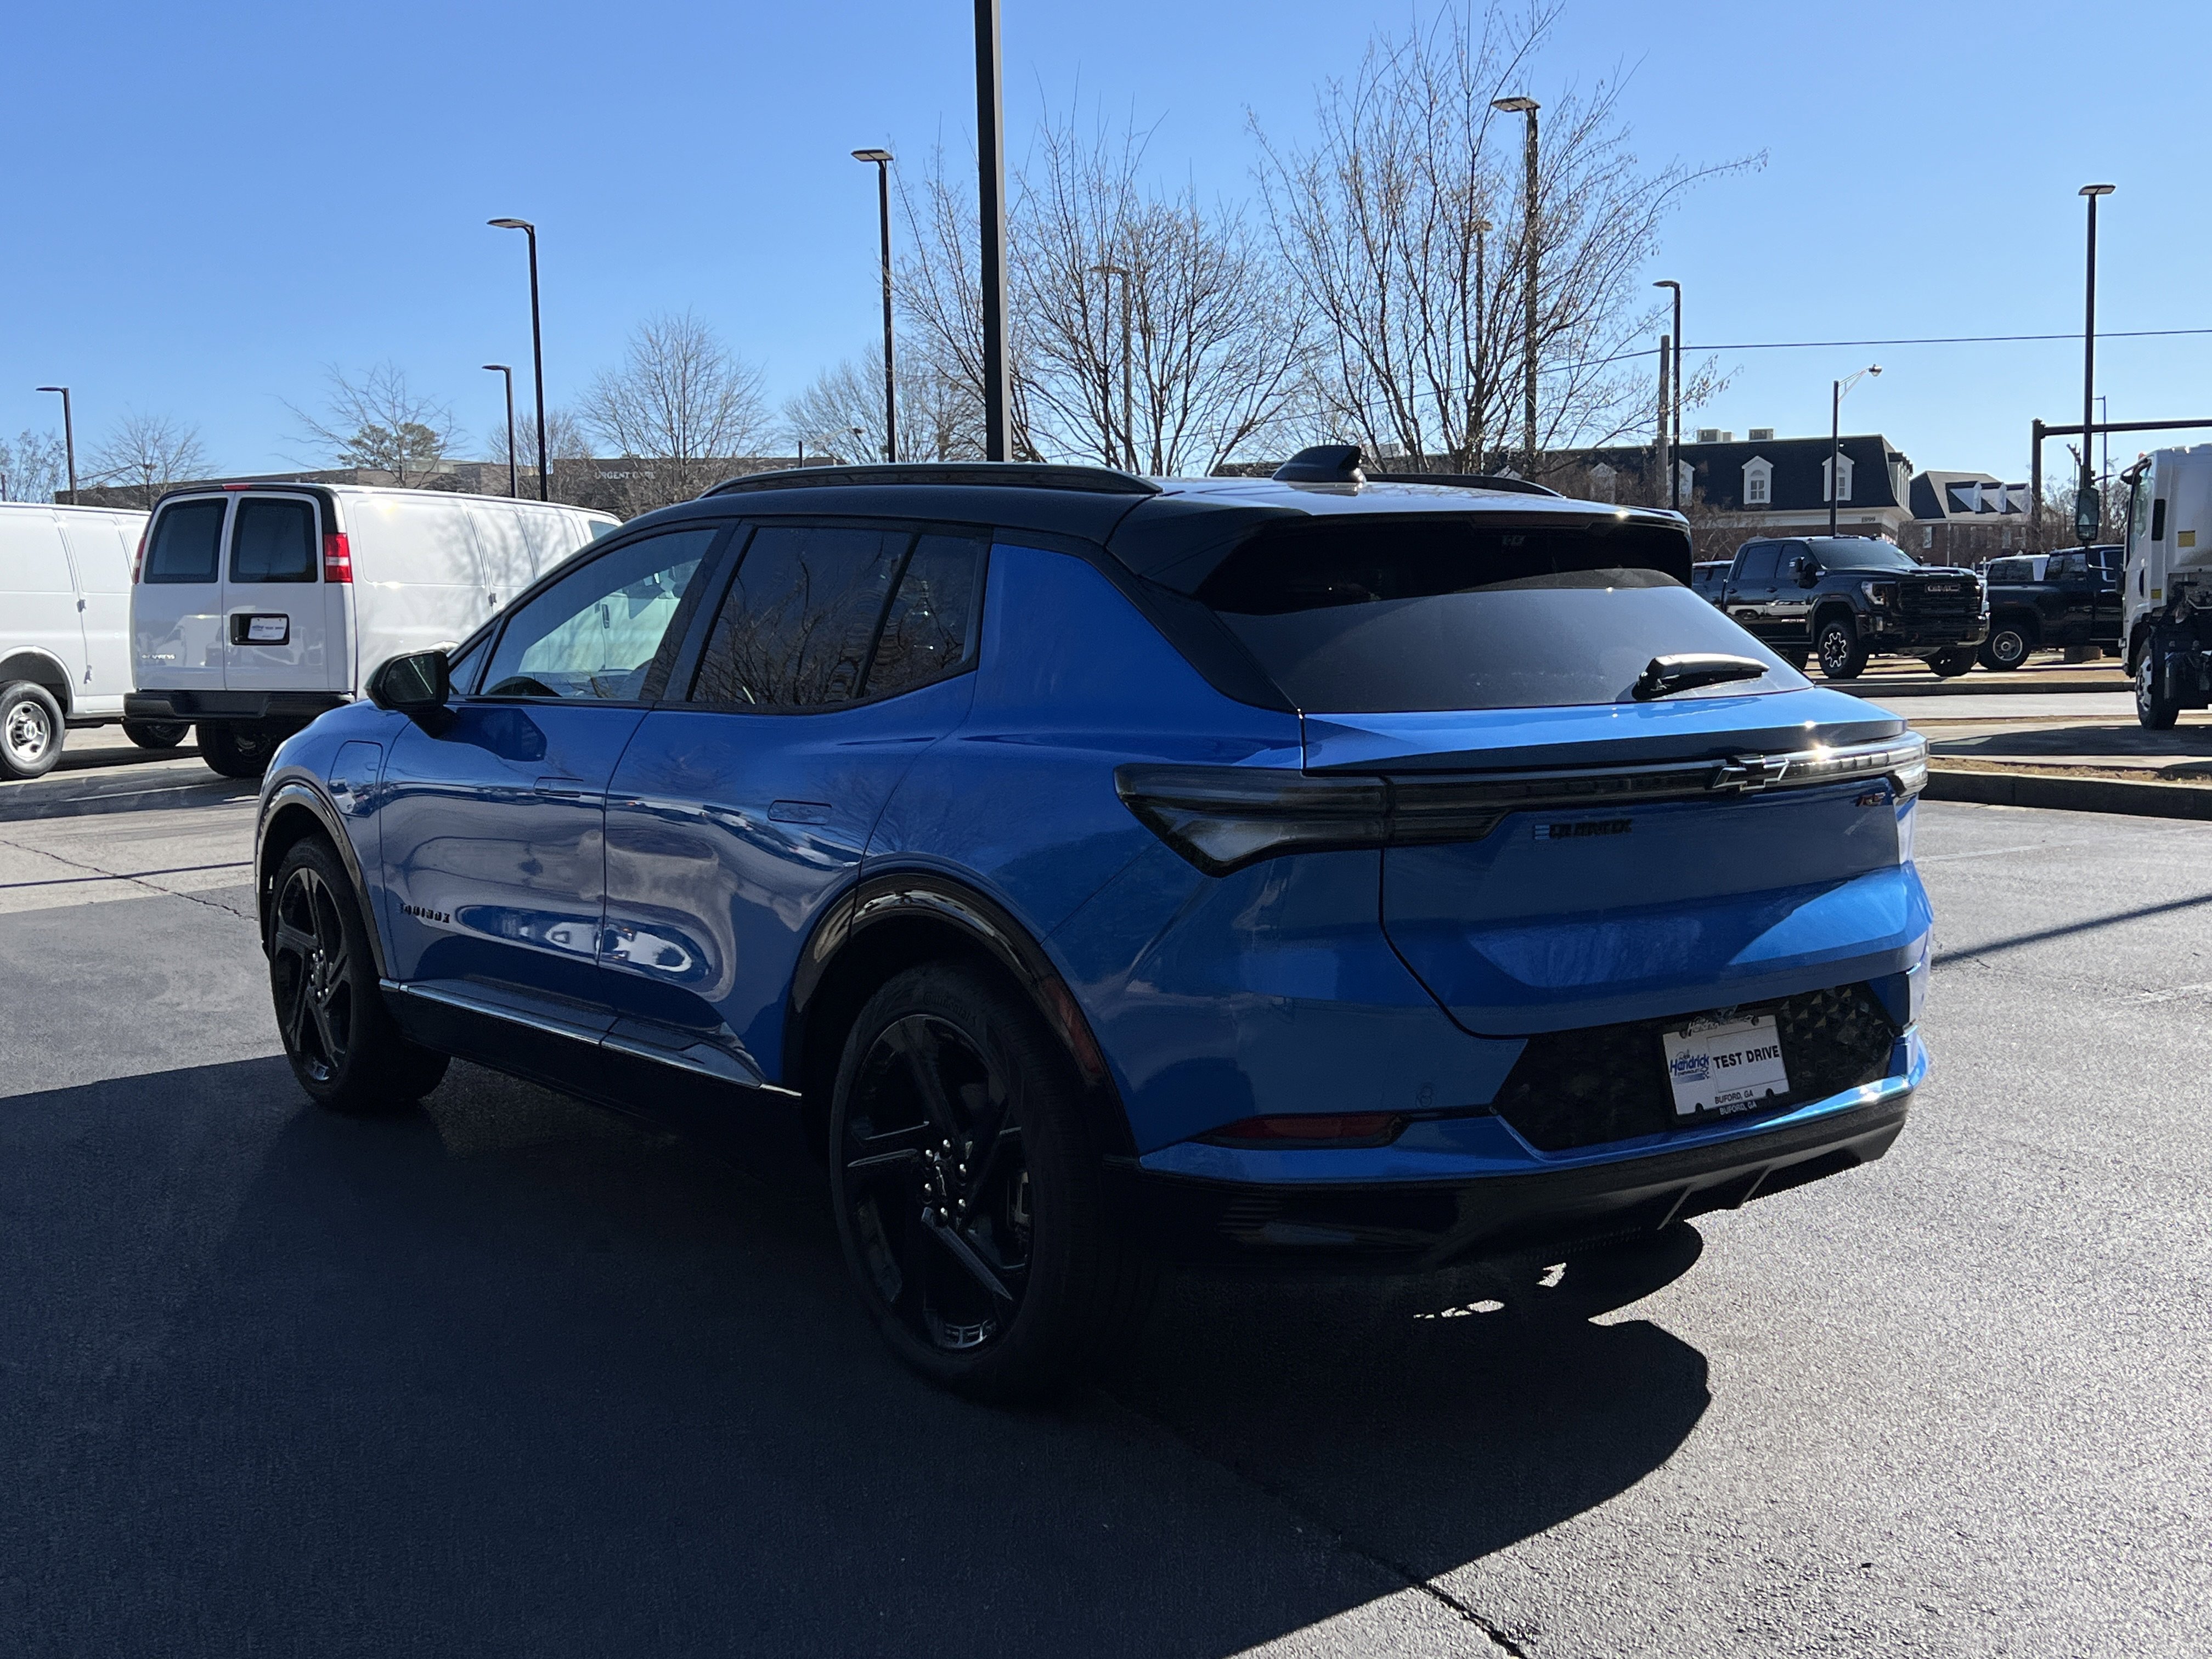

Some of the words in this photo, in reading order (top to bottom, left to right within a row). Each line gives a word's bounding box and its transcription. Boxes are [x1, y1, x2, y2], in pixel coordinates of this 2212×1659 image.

[594, 471, 630, 479] URGENT
[1713, 1052, 1742, 1069] TEST
[1746, 1045, 1780, 1063] DRIVE
[1670, 1053, 1709, 1076] Hendrick
[1715, 1092, 1743, 1104] BUFORD,
[1744, 1090, 1754, 1098] GA
[1747, 1100, 1757, 1110] GA
